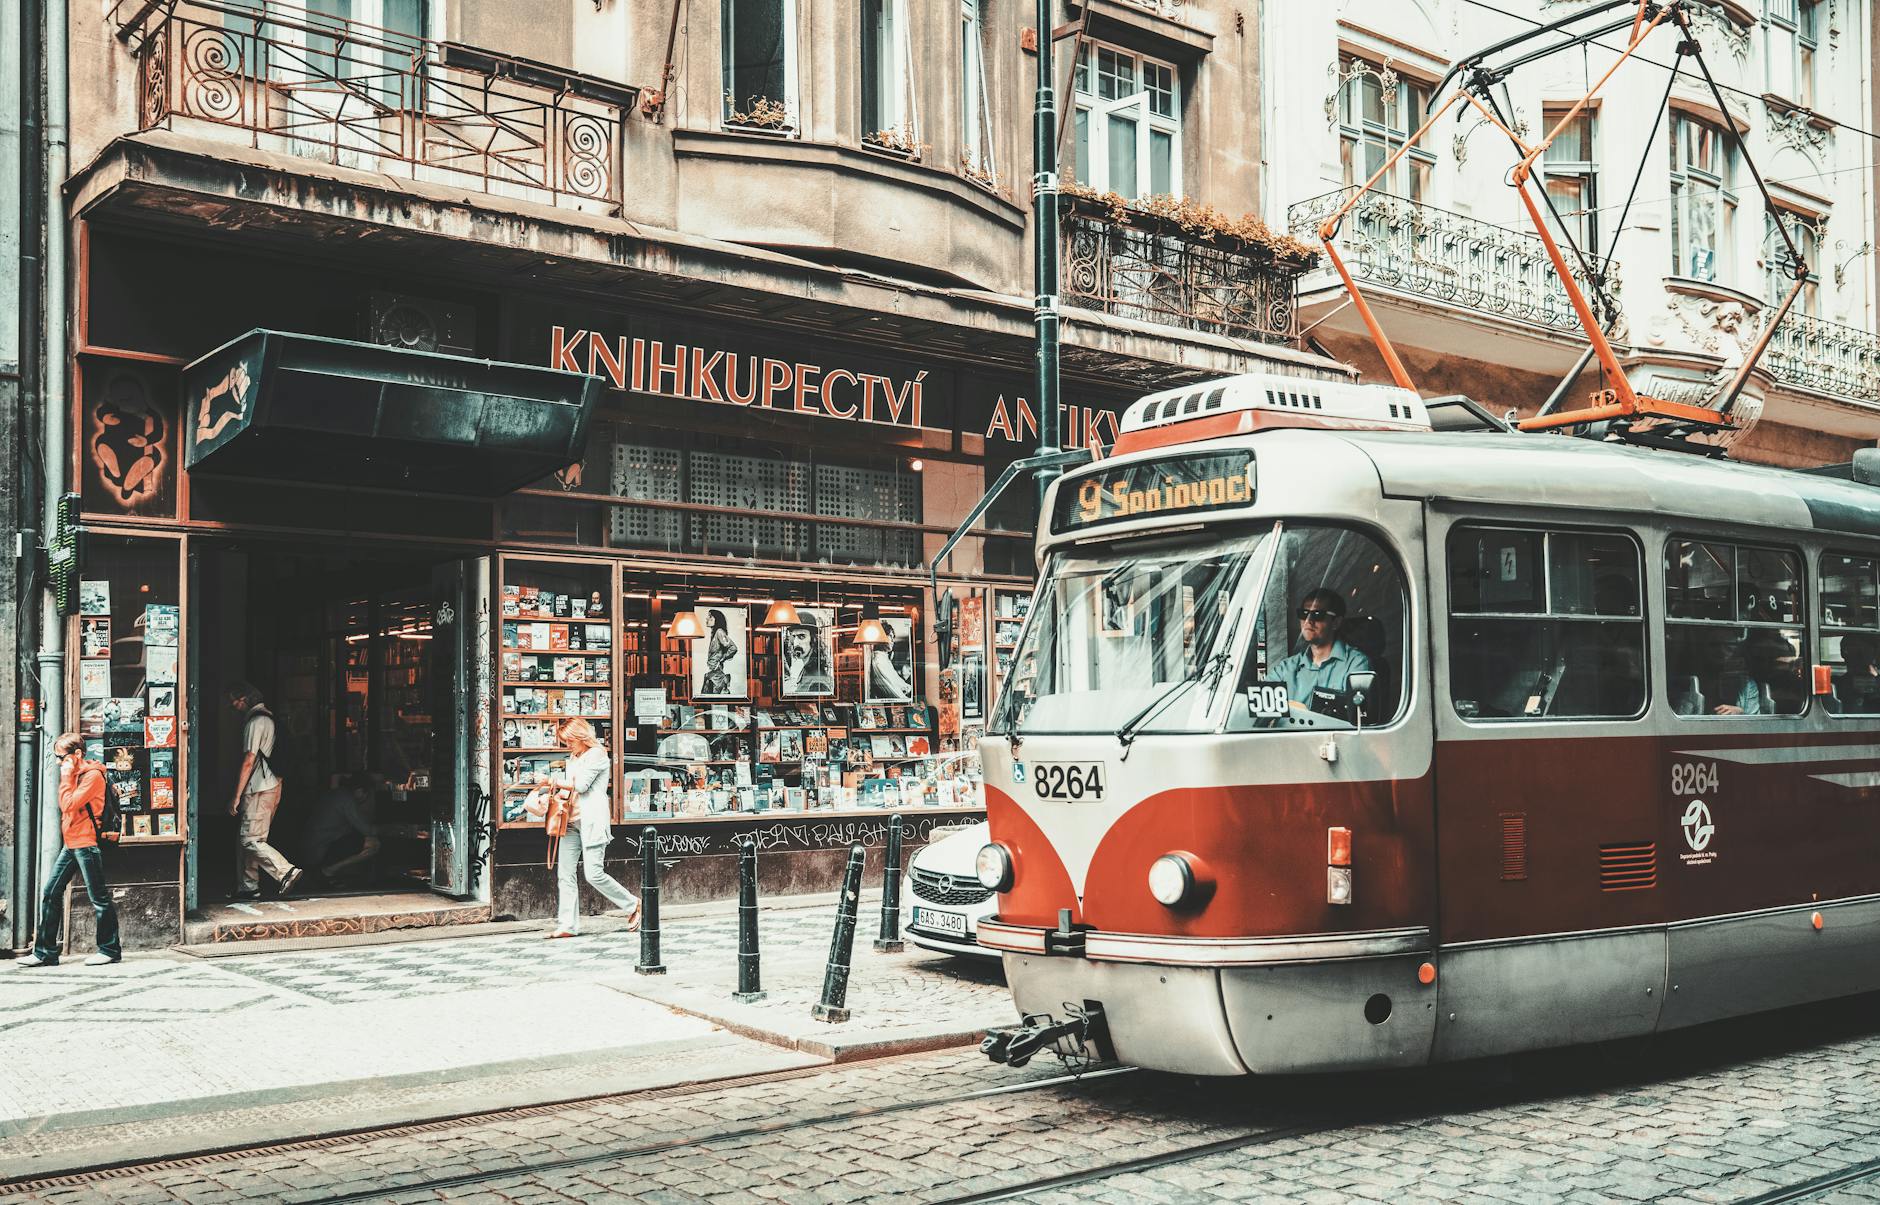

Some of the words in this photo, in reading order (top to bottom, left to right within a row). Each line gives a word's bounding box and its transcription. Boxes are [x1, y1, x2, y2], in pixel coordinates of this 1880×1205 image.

[550, 325, 929, 428] KNIHKUPECTVÍ
[985, 393, 1121, 449] ANIK
[1078, 479, 1102, 522] 9
[1247, 686, 1289, 713] 508
[1034, 765, 1104, 799] 8264
[1671, 762, 1720, 796] 8264
[920, 911, 935, 925] 6AS
[940, 914, 962, 930] 3480
